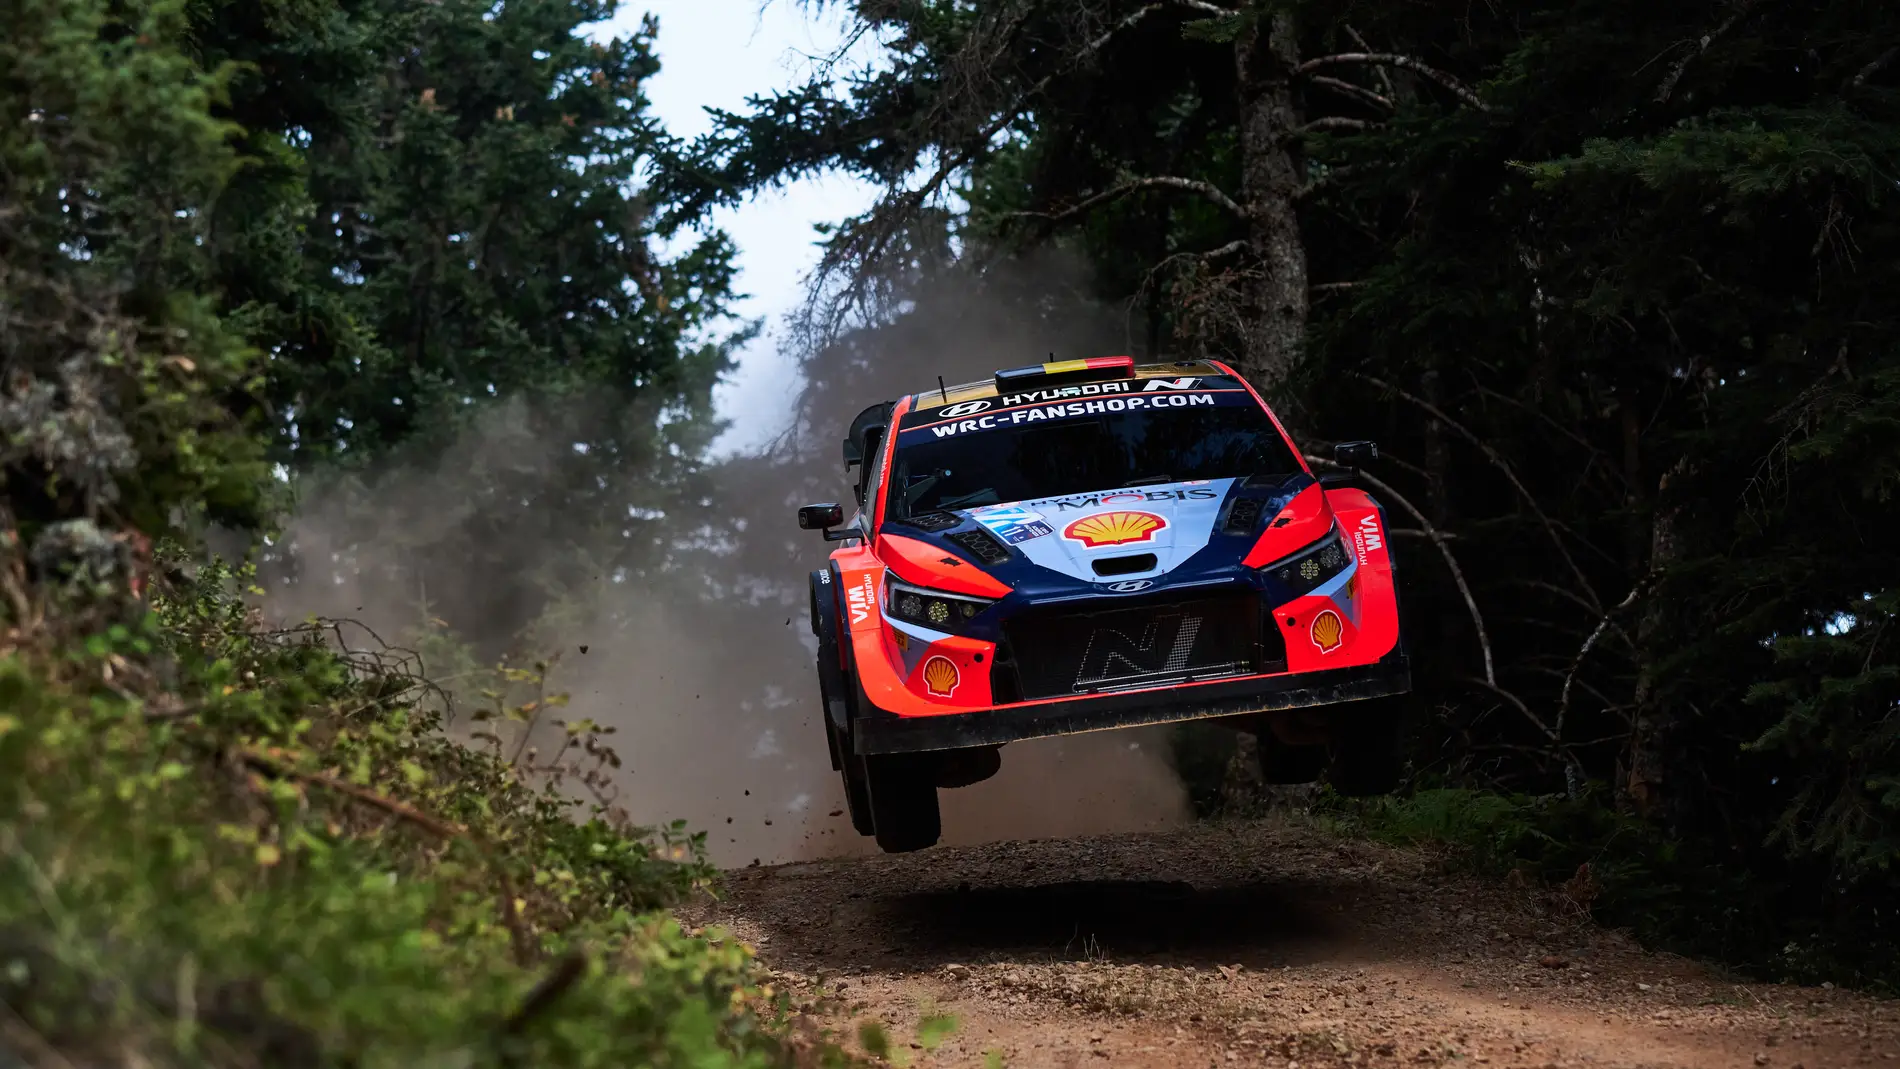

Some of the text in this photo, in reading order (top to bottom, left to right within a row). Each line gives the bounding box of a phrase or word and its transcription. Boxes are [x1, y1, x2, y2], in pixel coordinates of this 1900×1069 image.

[1002, 382, 1130, 406] HYUNDAI
[932, 394, 1215, 438] WRC-FANSHOP.COM
[1031, 489, 1142, 507] HYUNDAI
[1057, 489, 1217, 512] MOBIS
[1359, 514, 1382, 551] WIA
[1354, 532, 1368, 566] HYUNDAI
[848, 585, 870, 624] WIA
[863, 573, 875, 604] HYUNDAI
